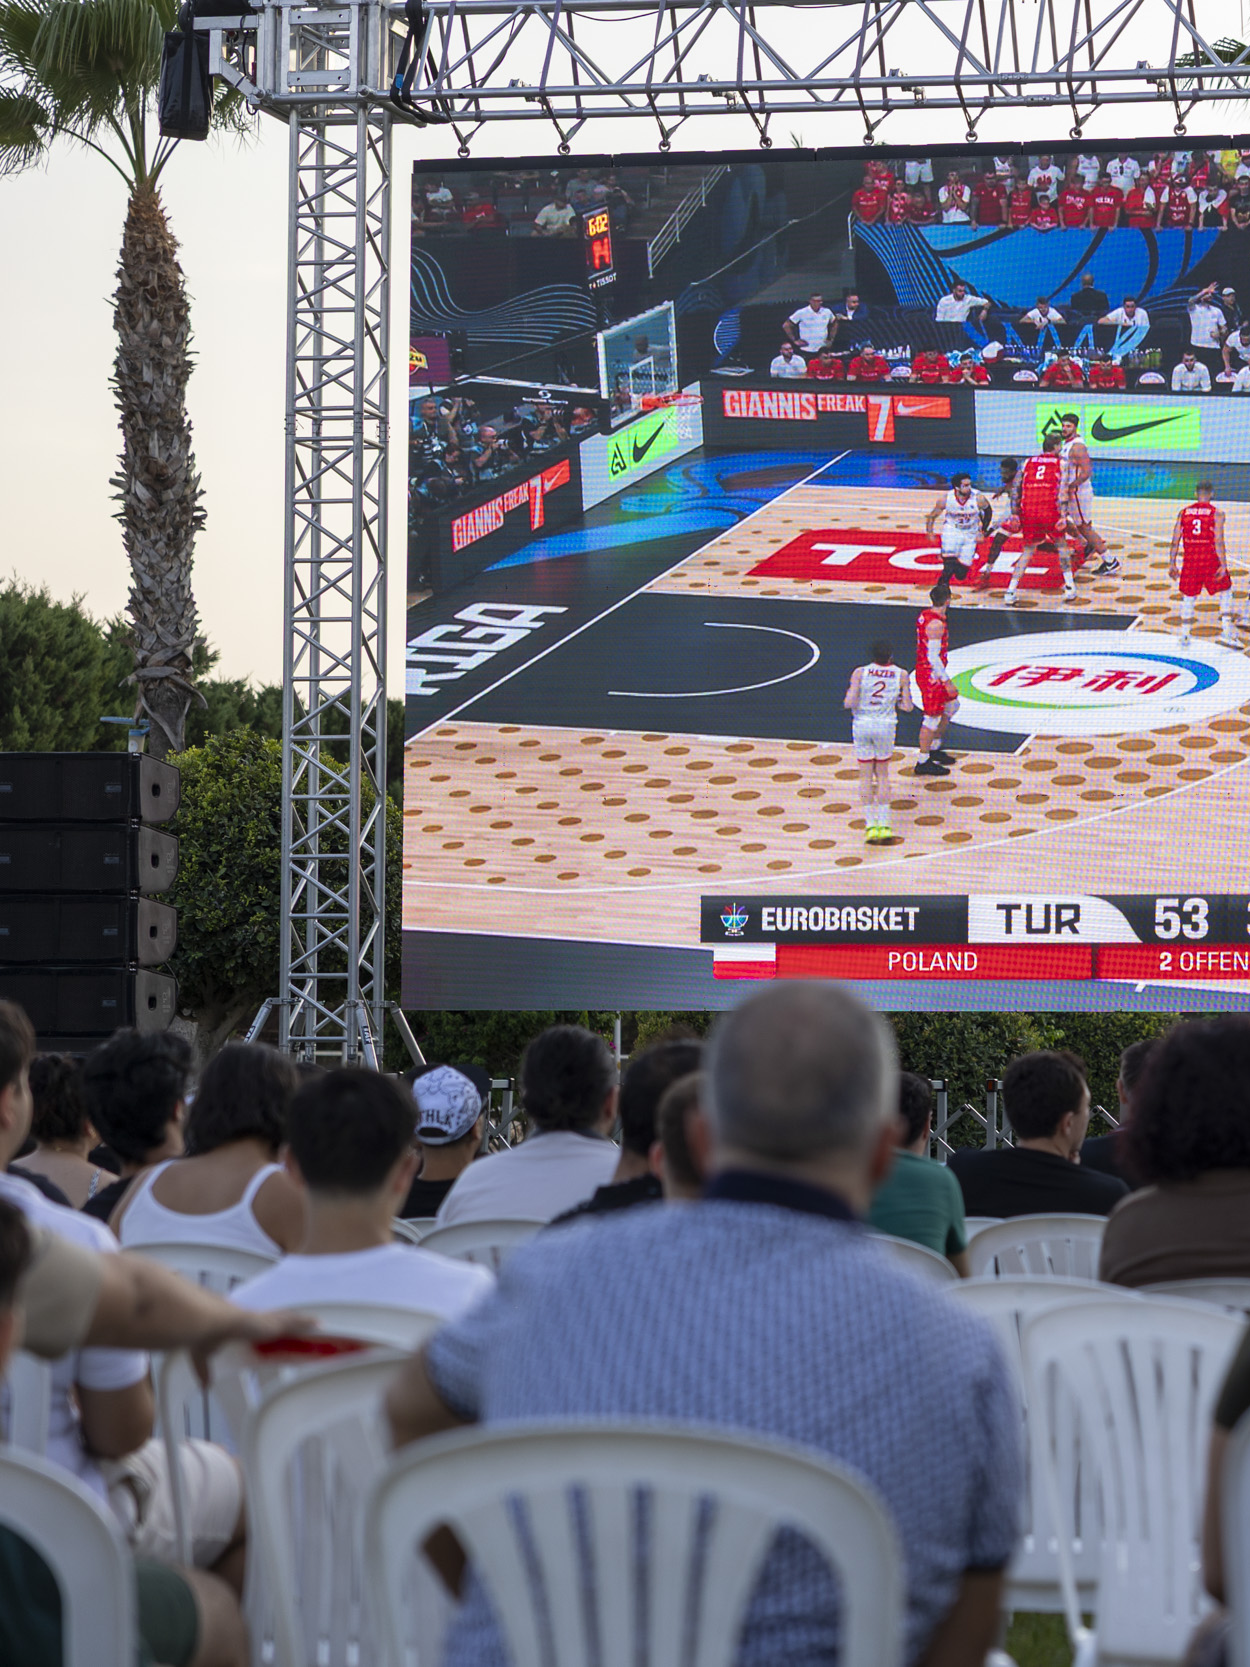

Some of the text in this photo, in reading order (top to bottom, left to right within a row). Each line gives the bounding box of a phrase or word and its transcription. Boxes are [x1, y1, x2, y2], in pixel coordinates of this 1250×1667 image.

[723, 390, 892, 441] GIANNIS FREAK 7
[1035, 465, 1047, 480] 2
[452, 475, 543, 553] GIANNIS FREAK 7
[1192, 518, 1202, 535] 3
[871, 680, 886, 698] 2
[987, 664, 1182, 695] 伊利
[761, 906, 921, 932] EUROBASKET
[996, 903, 1081, 935] TUR
[1154, 897, 1209, 940] 53
[888, 951, 978, 972] POLAND
[1159, 951, 1173, 972] 2
